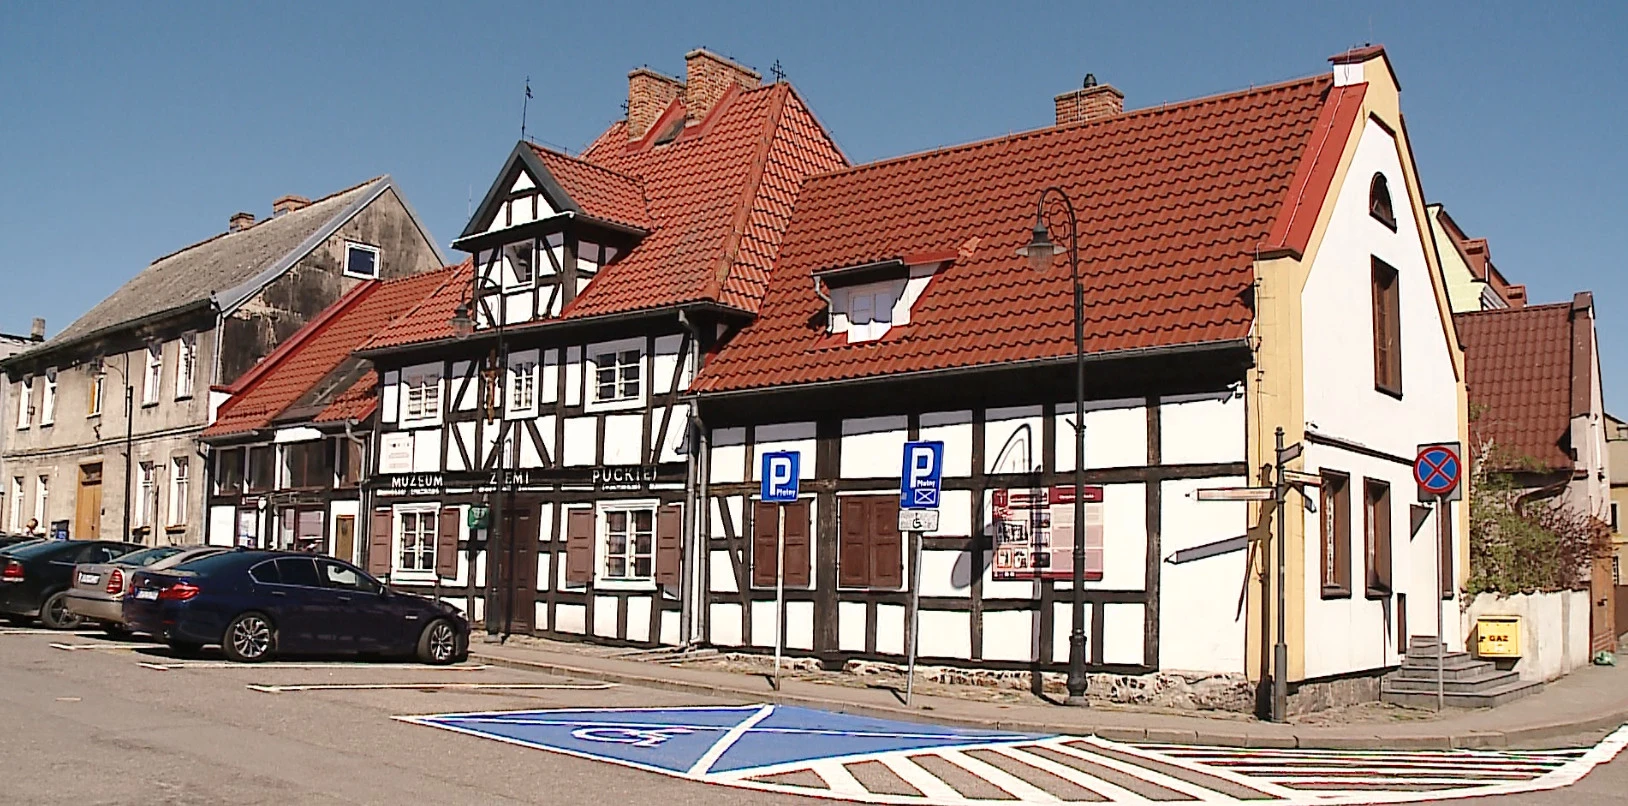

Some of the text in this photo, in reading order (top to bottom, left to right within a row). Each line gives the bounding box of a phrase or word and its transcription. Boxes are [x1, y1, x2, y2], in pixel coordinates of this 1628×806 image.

[391, 466, 657, 488] MUZEUM ZEMI PUCKIEJ
[769, 457, 792, 496] P
[909, 447, 935, 489] P
